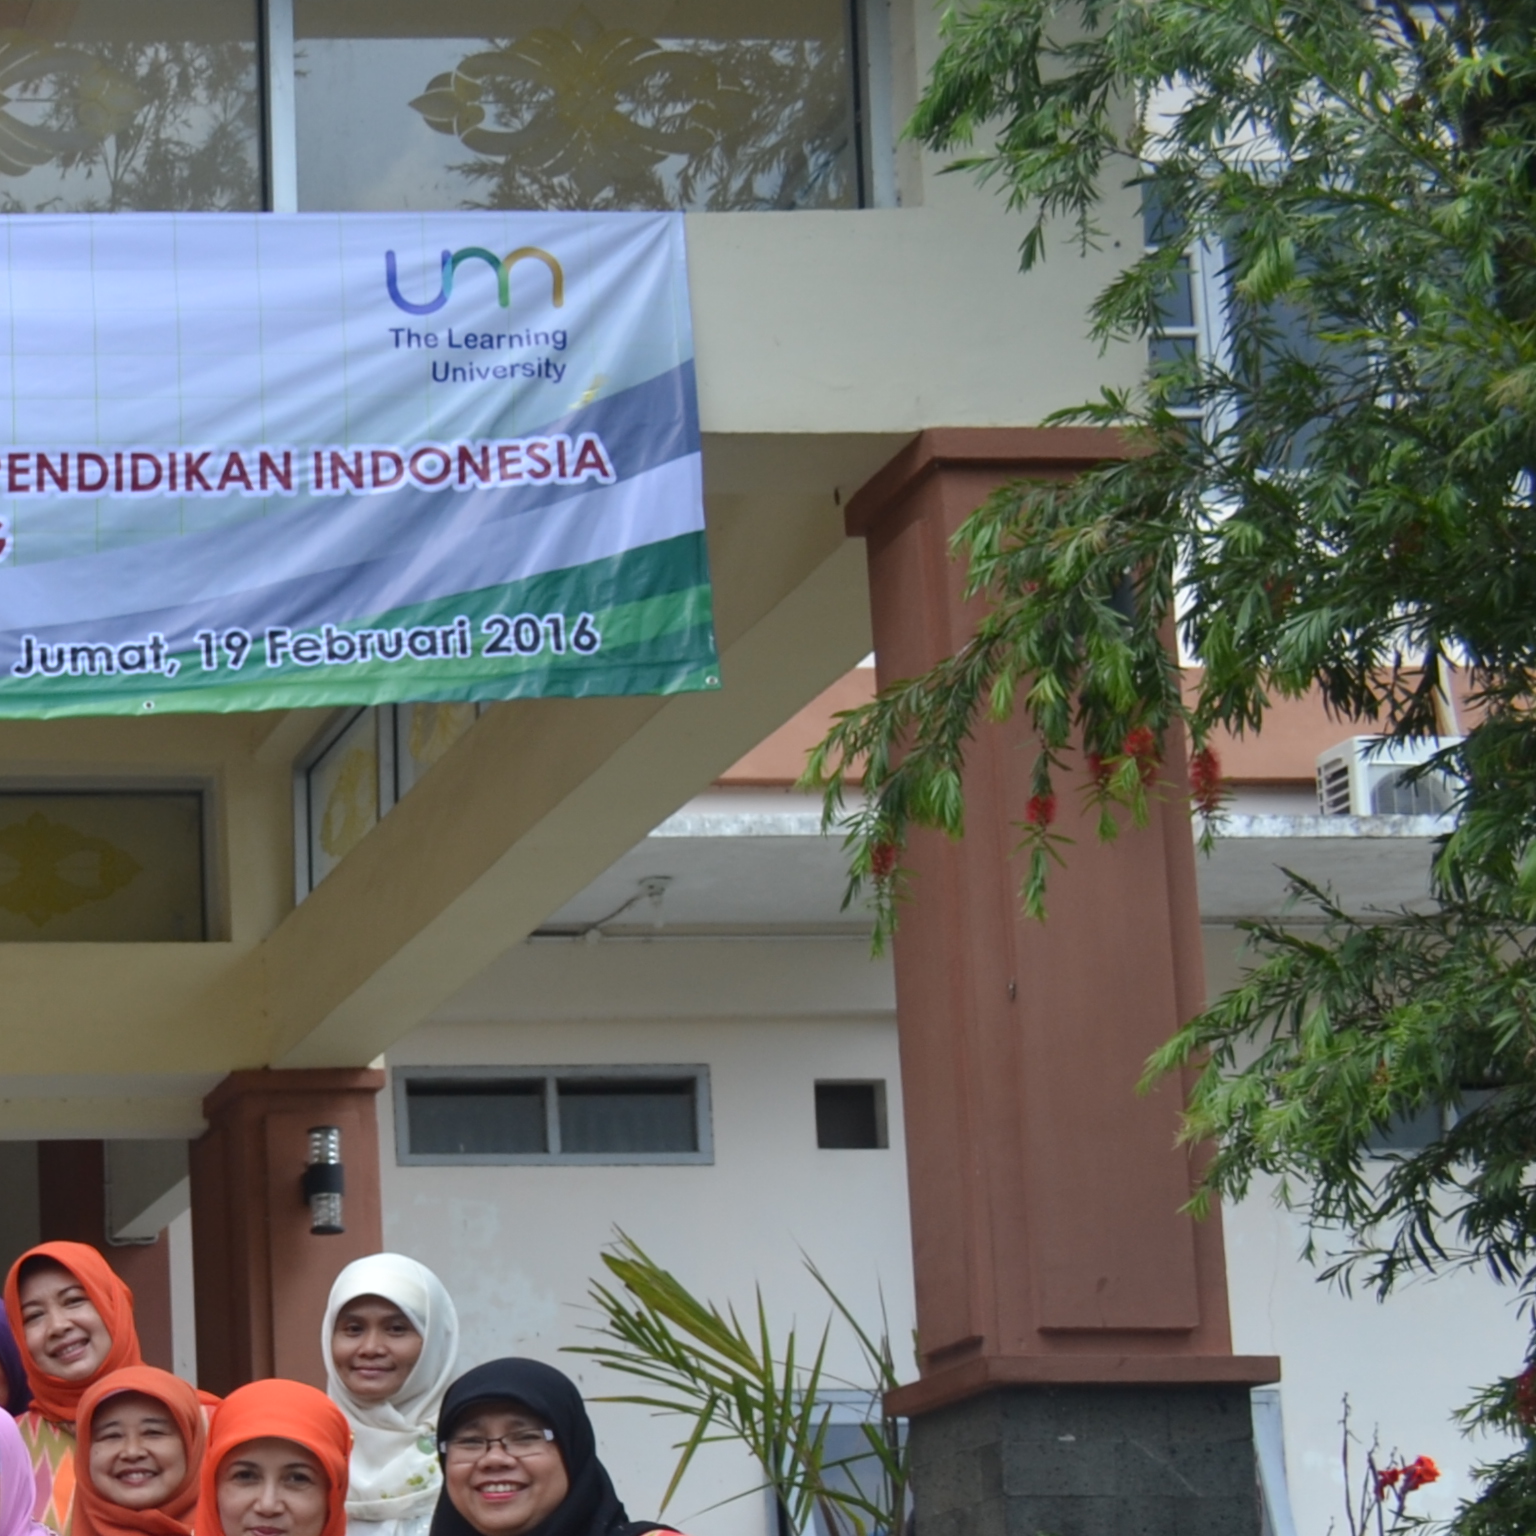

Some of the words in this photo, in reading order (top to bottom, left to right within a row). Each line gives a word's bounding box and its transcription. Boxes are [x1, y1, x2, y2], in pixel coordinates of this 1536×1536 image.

[389, 327, 441, 350] The
[448, 326, 567, 351] Learning
[431, 358, 567, 384] University
[313, 437, 610, 491] INDONESIA
[13, 634, 179, 678] Jumat,
[196, 630, 247, 668] 19
[268, 618, 469, 666] Februari
[483, 613, 599, 655] 2016
